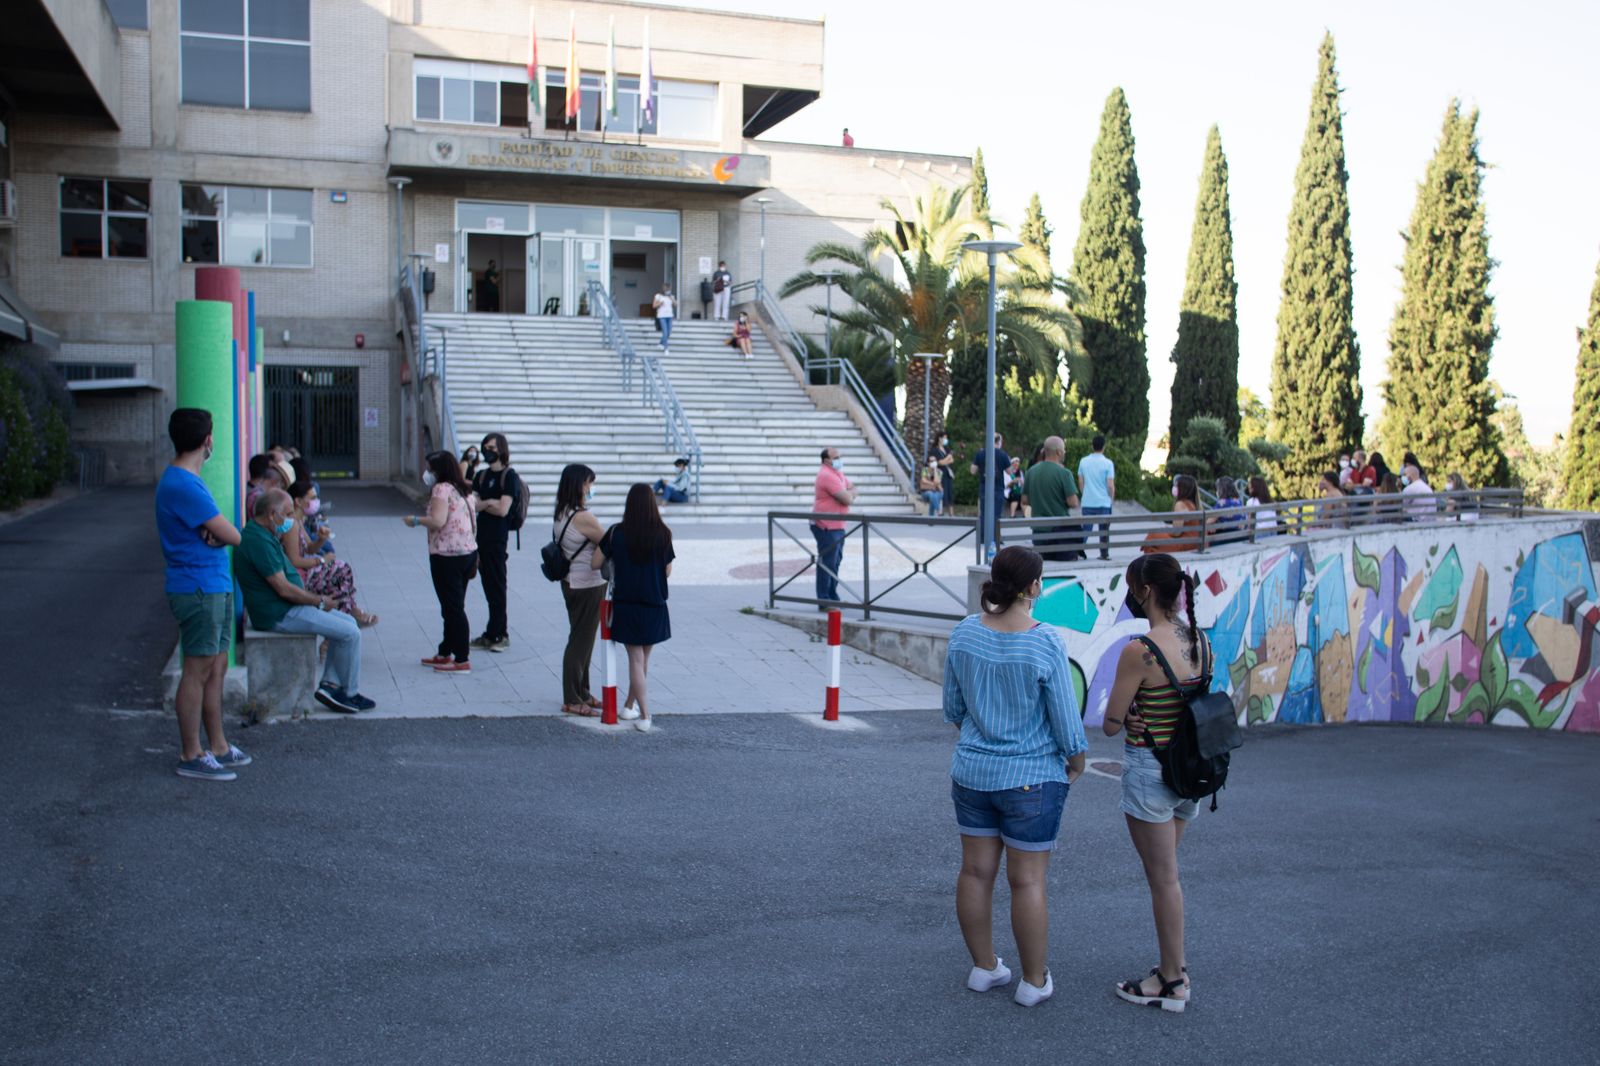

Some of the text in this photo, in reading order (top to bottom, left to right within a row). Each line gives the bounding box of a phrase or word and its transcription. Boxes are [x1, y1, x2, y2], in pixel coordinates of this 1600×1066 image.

[500, 141, 679, 164] FACULTAD DE CIENCIAS
